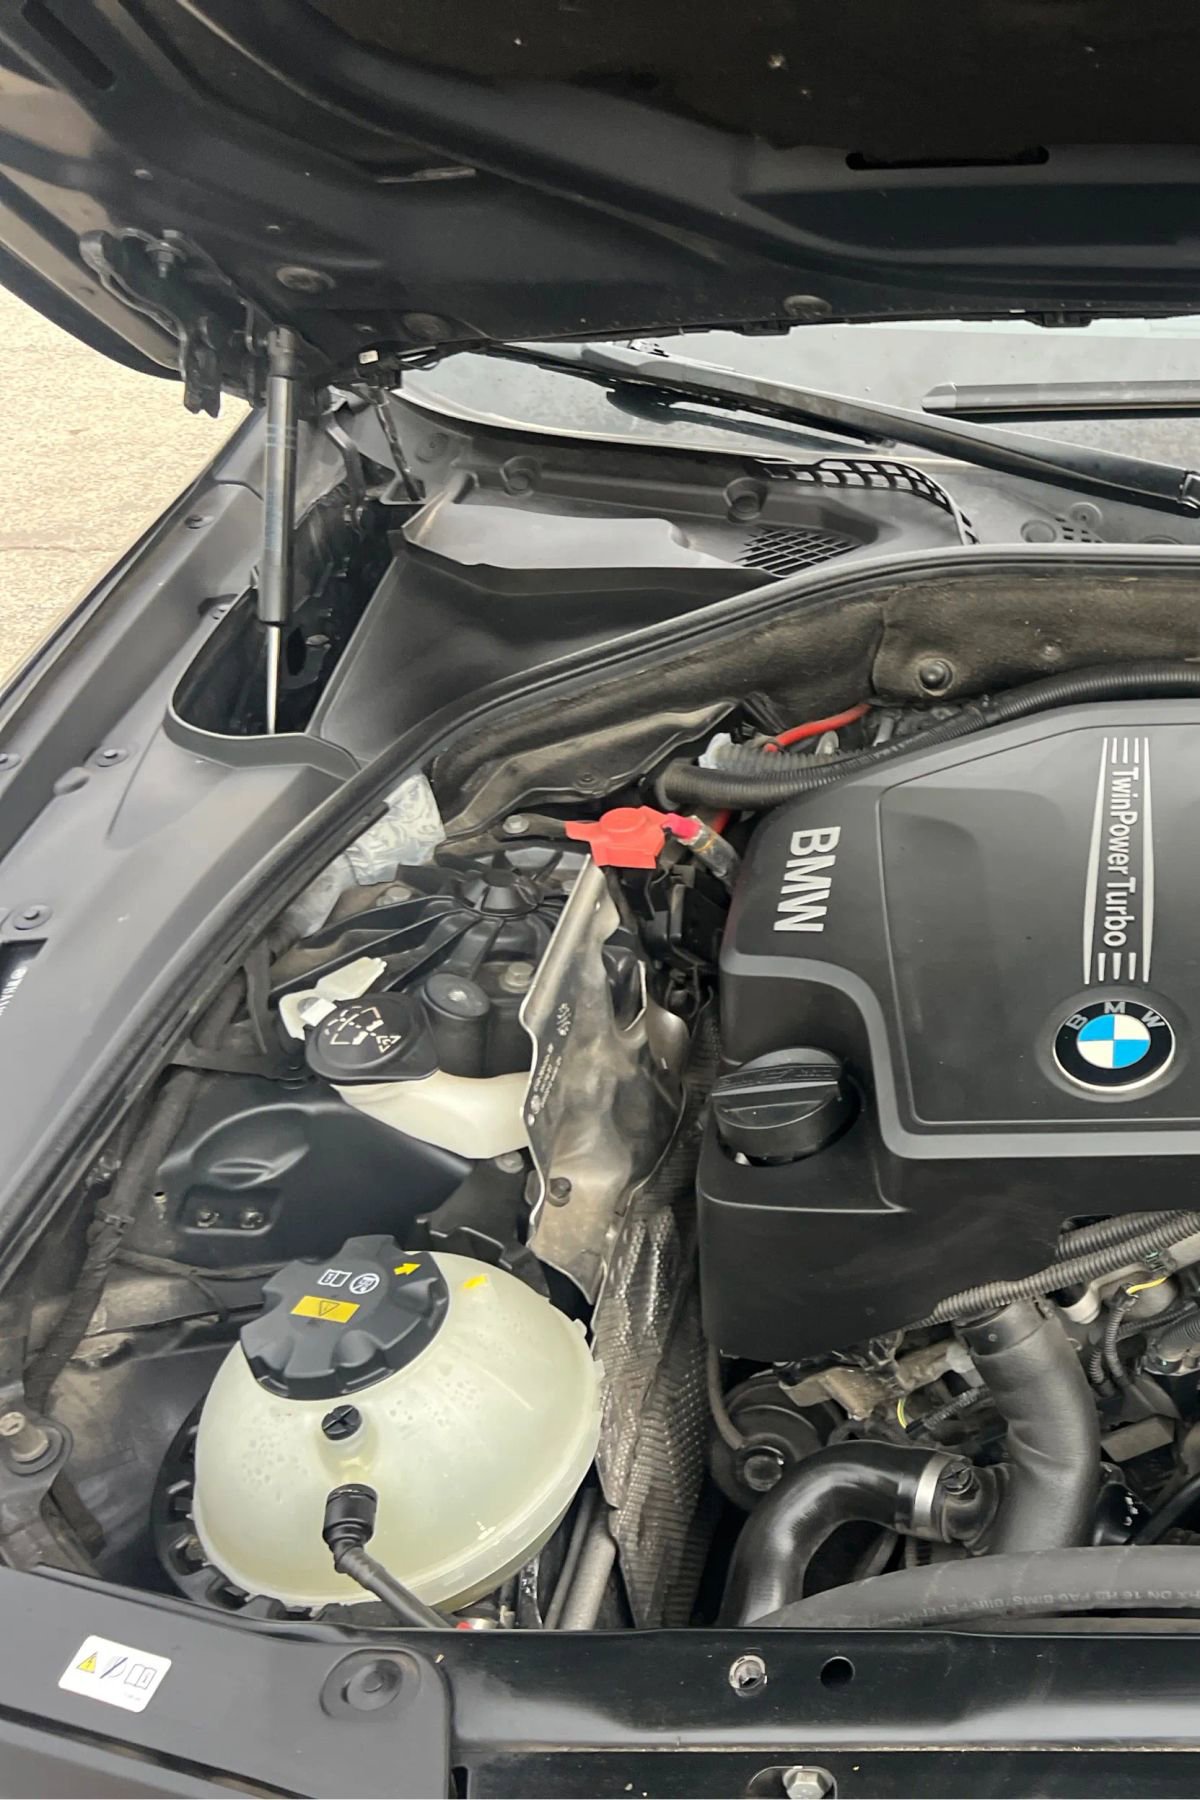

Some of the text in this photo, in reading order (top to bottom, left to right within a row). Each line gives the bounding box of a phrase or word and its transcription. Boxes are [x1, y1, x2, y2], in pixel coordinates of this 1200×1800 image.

[773, 826, 841, 932] BMW
[1103, 766, 1139, 947] TwinPower Turbo
[1065, 1001, 1165, 1030] BMW
